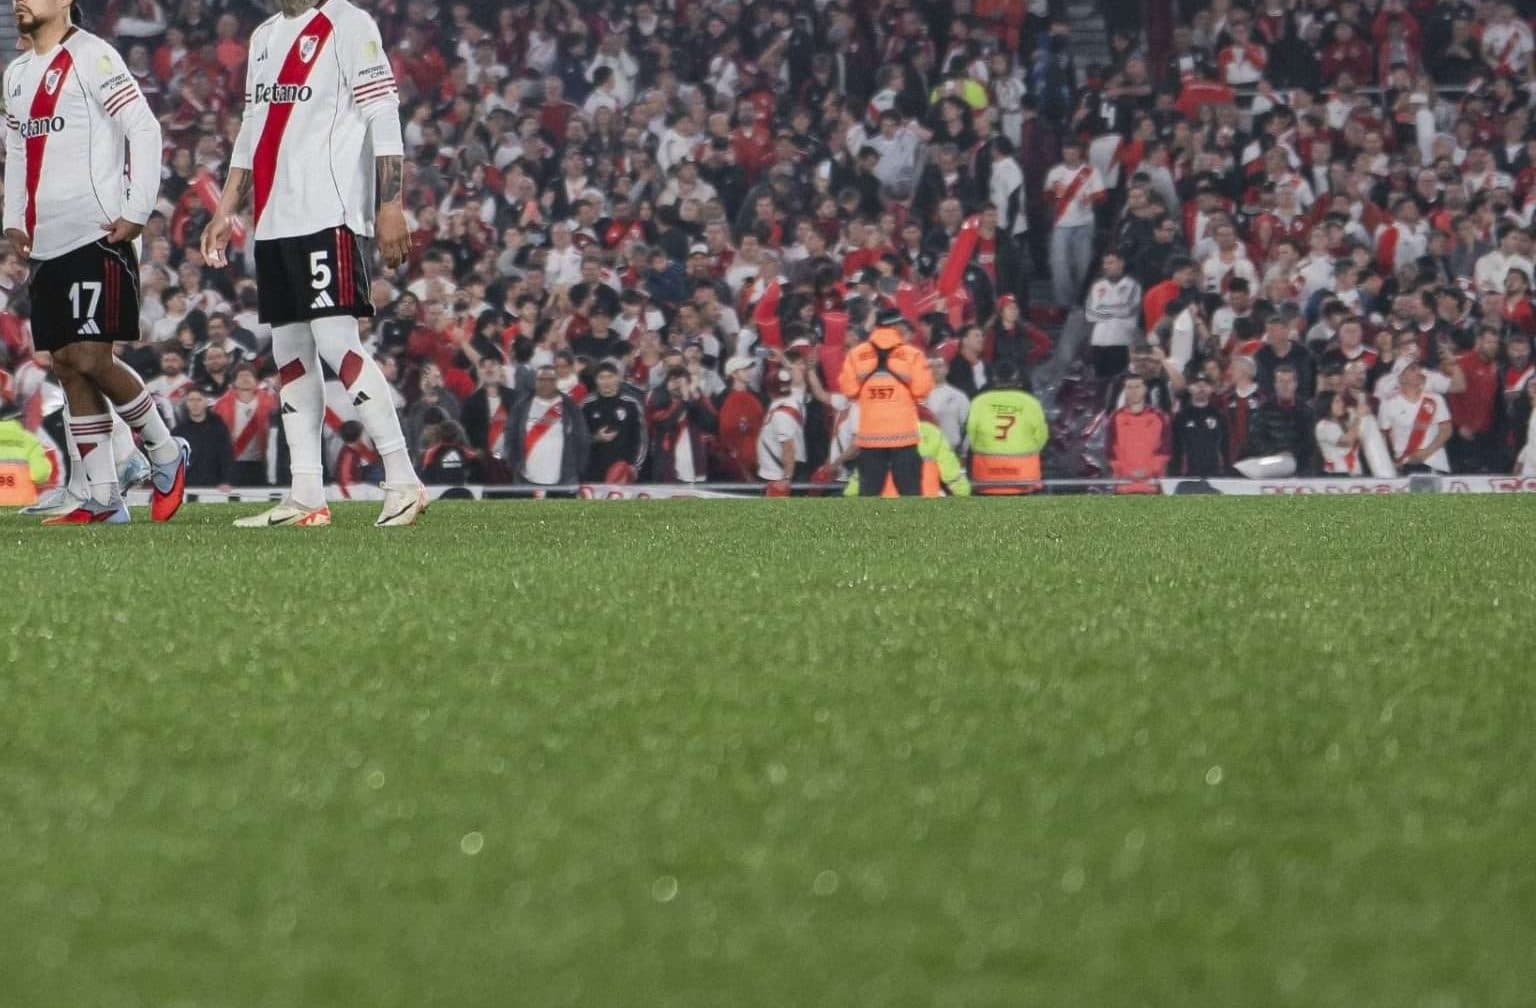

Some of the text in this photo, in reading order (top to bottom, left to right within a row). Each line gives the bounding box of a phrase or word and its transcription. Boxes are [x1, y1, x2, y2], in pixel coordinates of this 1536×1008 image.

[254, 82, 313, 104] Betano
[20, 116, 65, 138] etano
[310, 250, 332, 290] 5
[68, 281, 102, 319] 17
